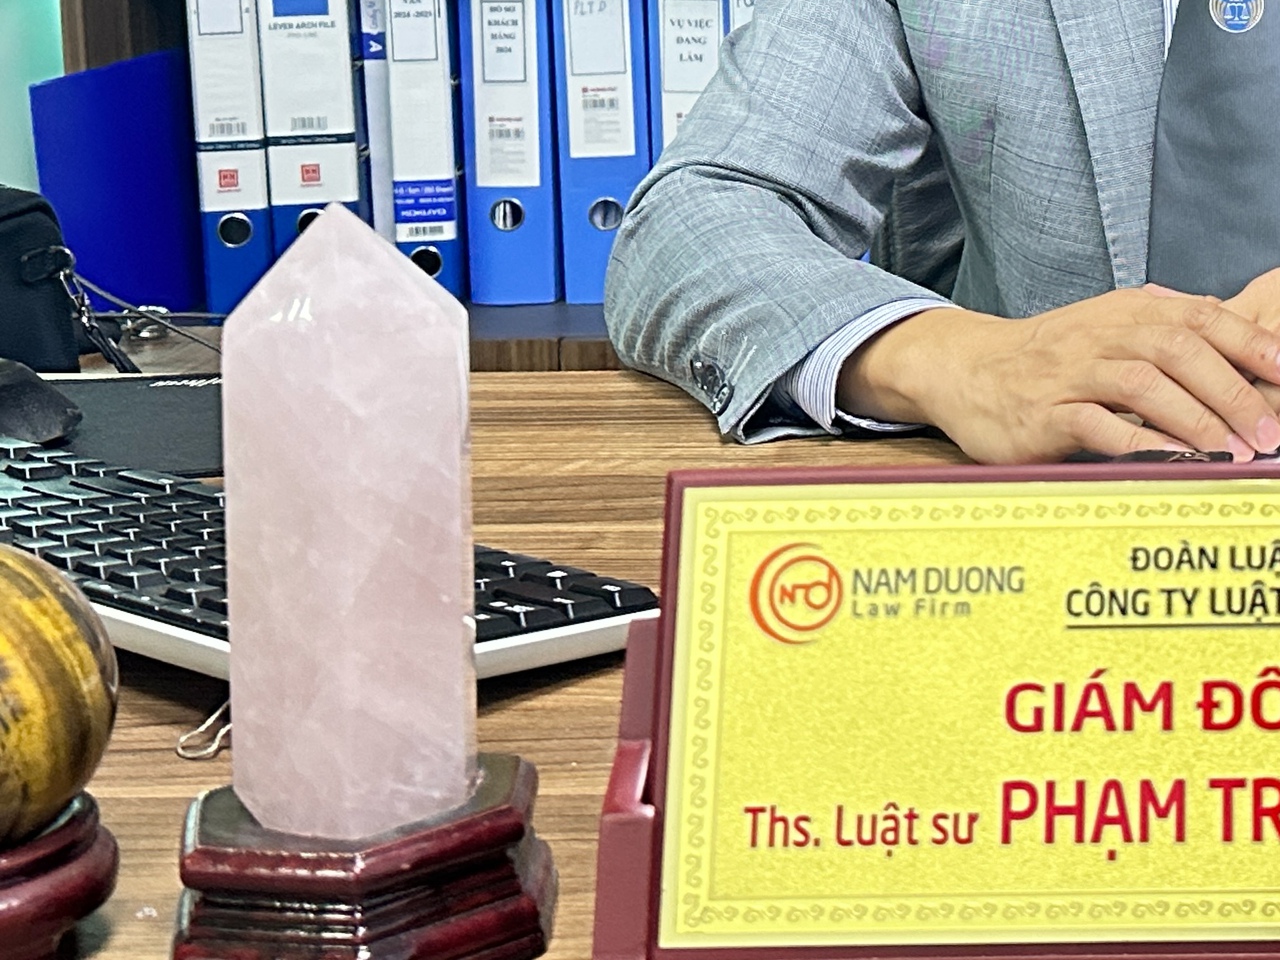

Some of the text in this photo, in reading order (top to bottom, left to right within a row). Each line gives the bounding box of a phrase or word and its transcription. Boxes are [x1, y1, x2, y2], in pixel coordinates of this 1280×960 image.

[368, 40, 383, 52] A
[1130, 540, 1219, 571] ĐOÀN
[852, 565, 1026, 595] NAM DUONG
[852, 598, 972, 617] Law Firm
[1065, 581, 1150, 617] CÔNG
[1157, 587, 1198, 616] TY
[1004, 668, 1176, 734] GIÁM
[743, 806, 822, 848] Ths.
[834, 802, 921, 857] Luật
[930, 810, 980, 846] sư
[1000, 776, 1188, 861] PHẠM
